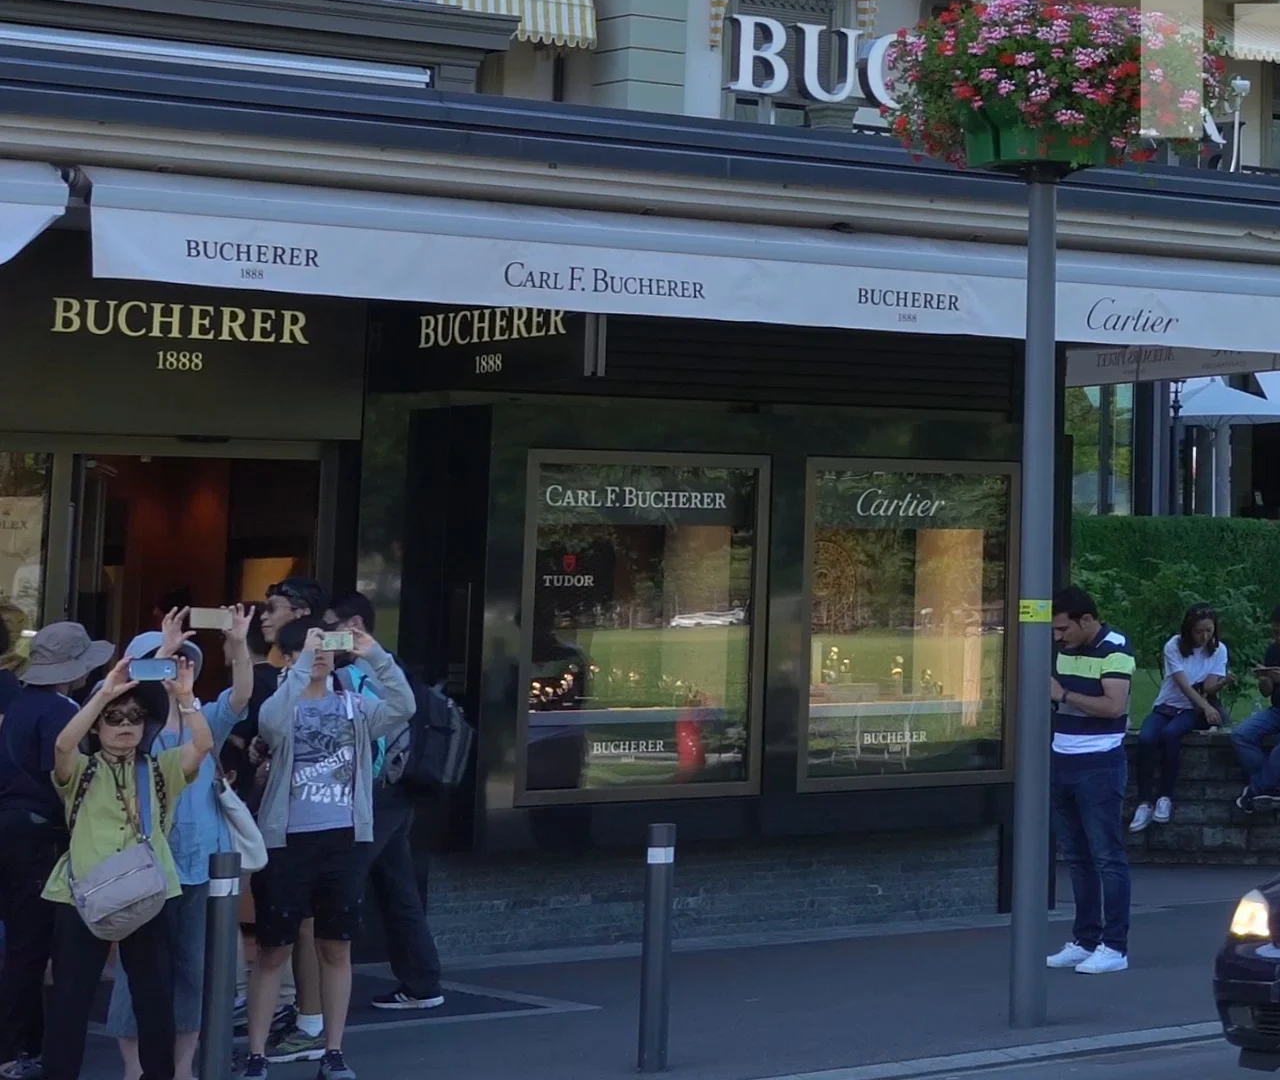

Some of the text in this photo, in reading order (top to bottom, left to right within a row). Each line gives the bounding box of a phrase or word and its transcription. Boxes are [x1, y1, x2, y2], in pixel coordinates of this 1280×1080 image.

[722, 13, 904, 110] BUC
[185, 239, 320, 268] BUCHERER
[240, 268, 264, 279] 1888
[568, 267, 585, 292] F.
[857, 287, 960, 312] BUCHERER
[51, 296, 310, 345] BUCHERER
[418, 307, 567, 349] BUCHERER
[1086, 296, 1179, 336] Cartier
[156, 350, 203, 371] 1888
[475, 353, 502, 374] 1888
[604, 486, 620, 508] F.
[856, 487, 946, 517] Cartier
[543, 575, 594, 587] TUDOR
[592, 740, 665, 754] BUCHERER
[863, 730, 928, 745] BUCHERER
